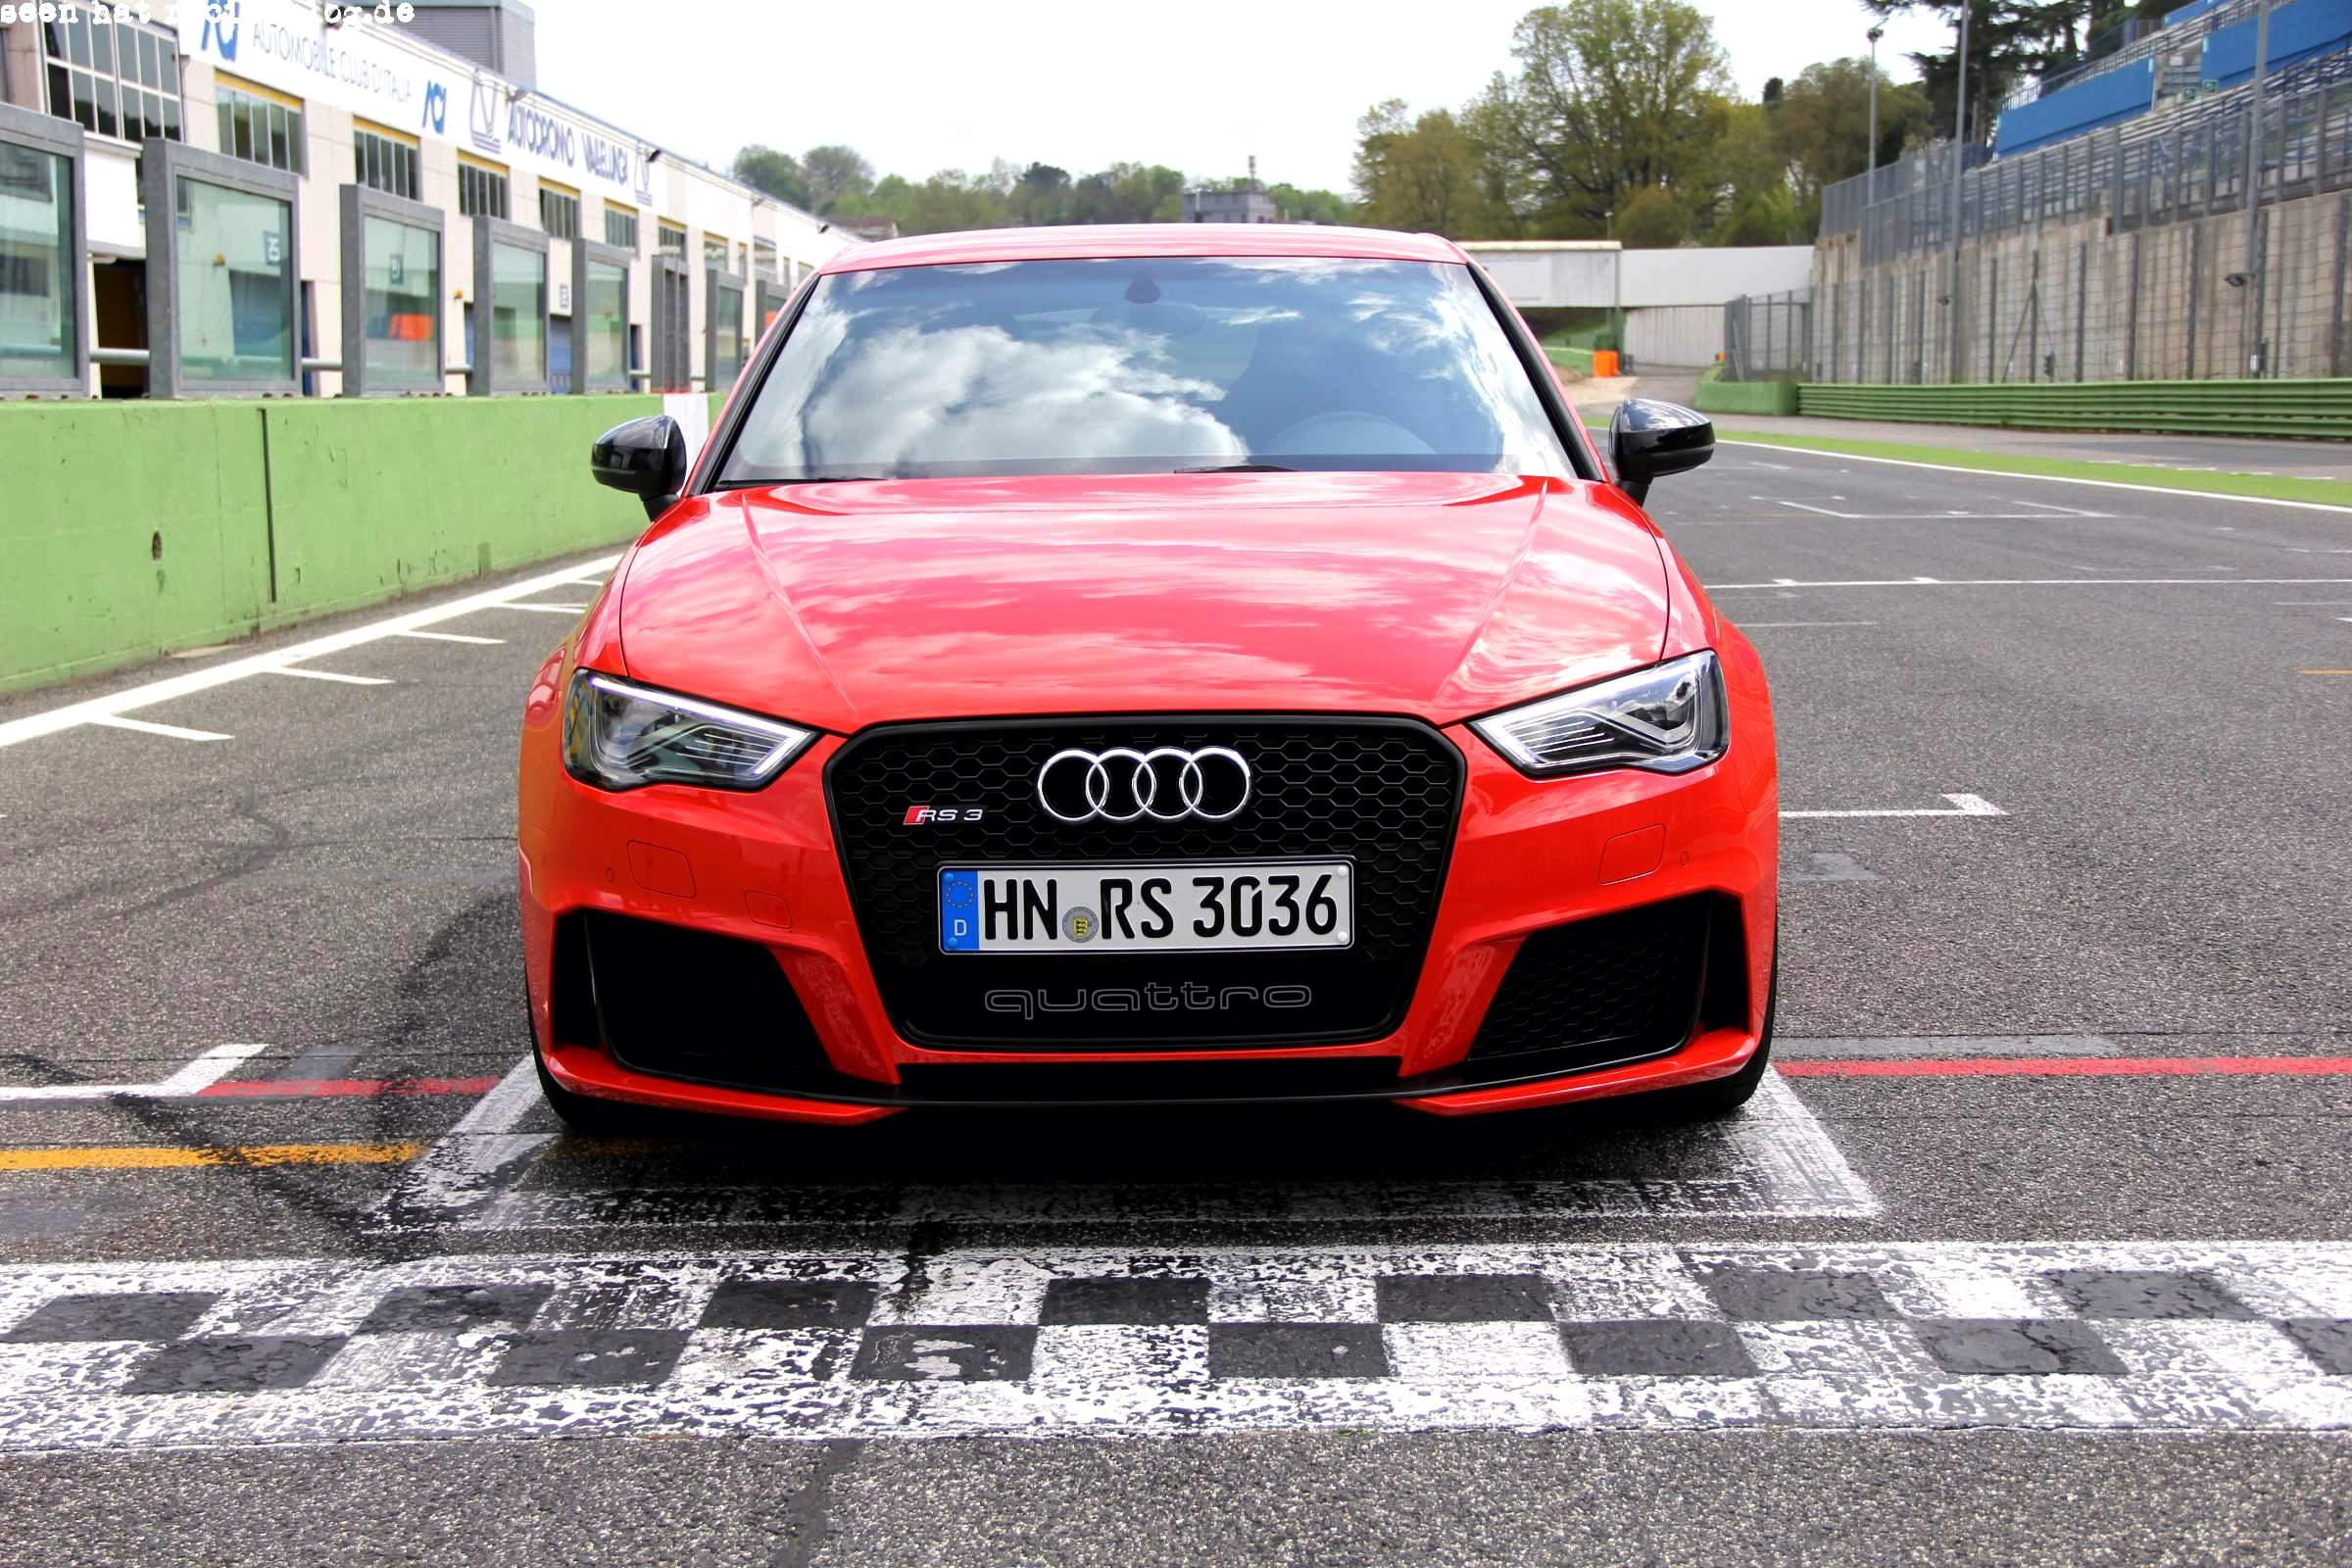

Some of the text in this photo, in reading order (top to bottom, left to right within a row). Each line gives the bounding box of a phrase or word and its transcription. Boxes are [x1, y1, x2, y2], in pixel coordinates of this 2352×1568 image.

[915, 808, 983, 822] RS 3
[984, 878, 1057, 940] HN
[1101, 878, 1174, 940] RS
[1192, 874, 1338, 938] 3036
[954, 918, 967, 937] D
[985, 982, 1311, 1020] quattro
